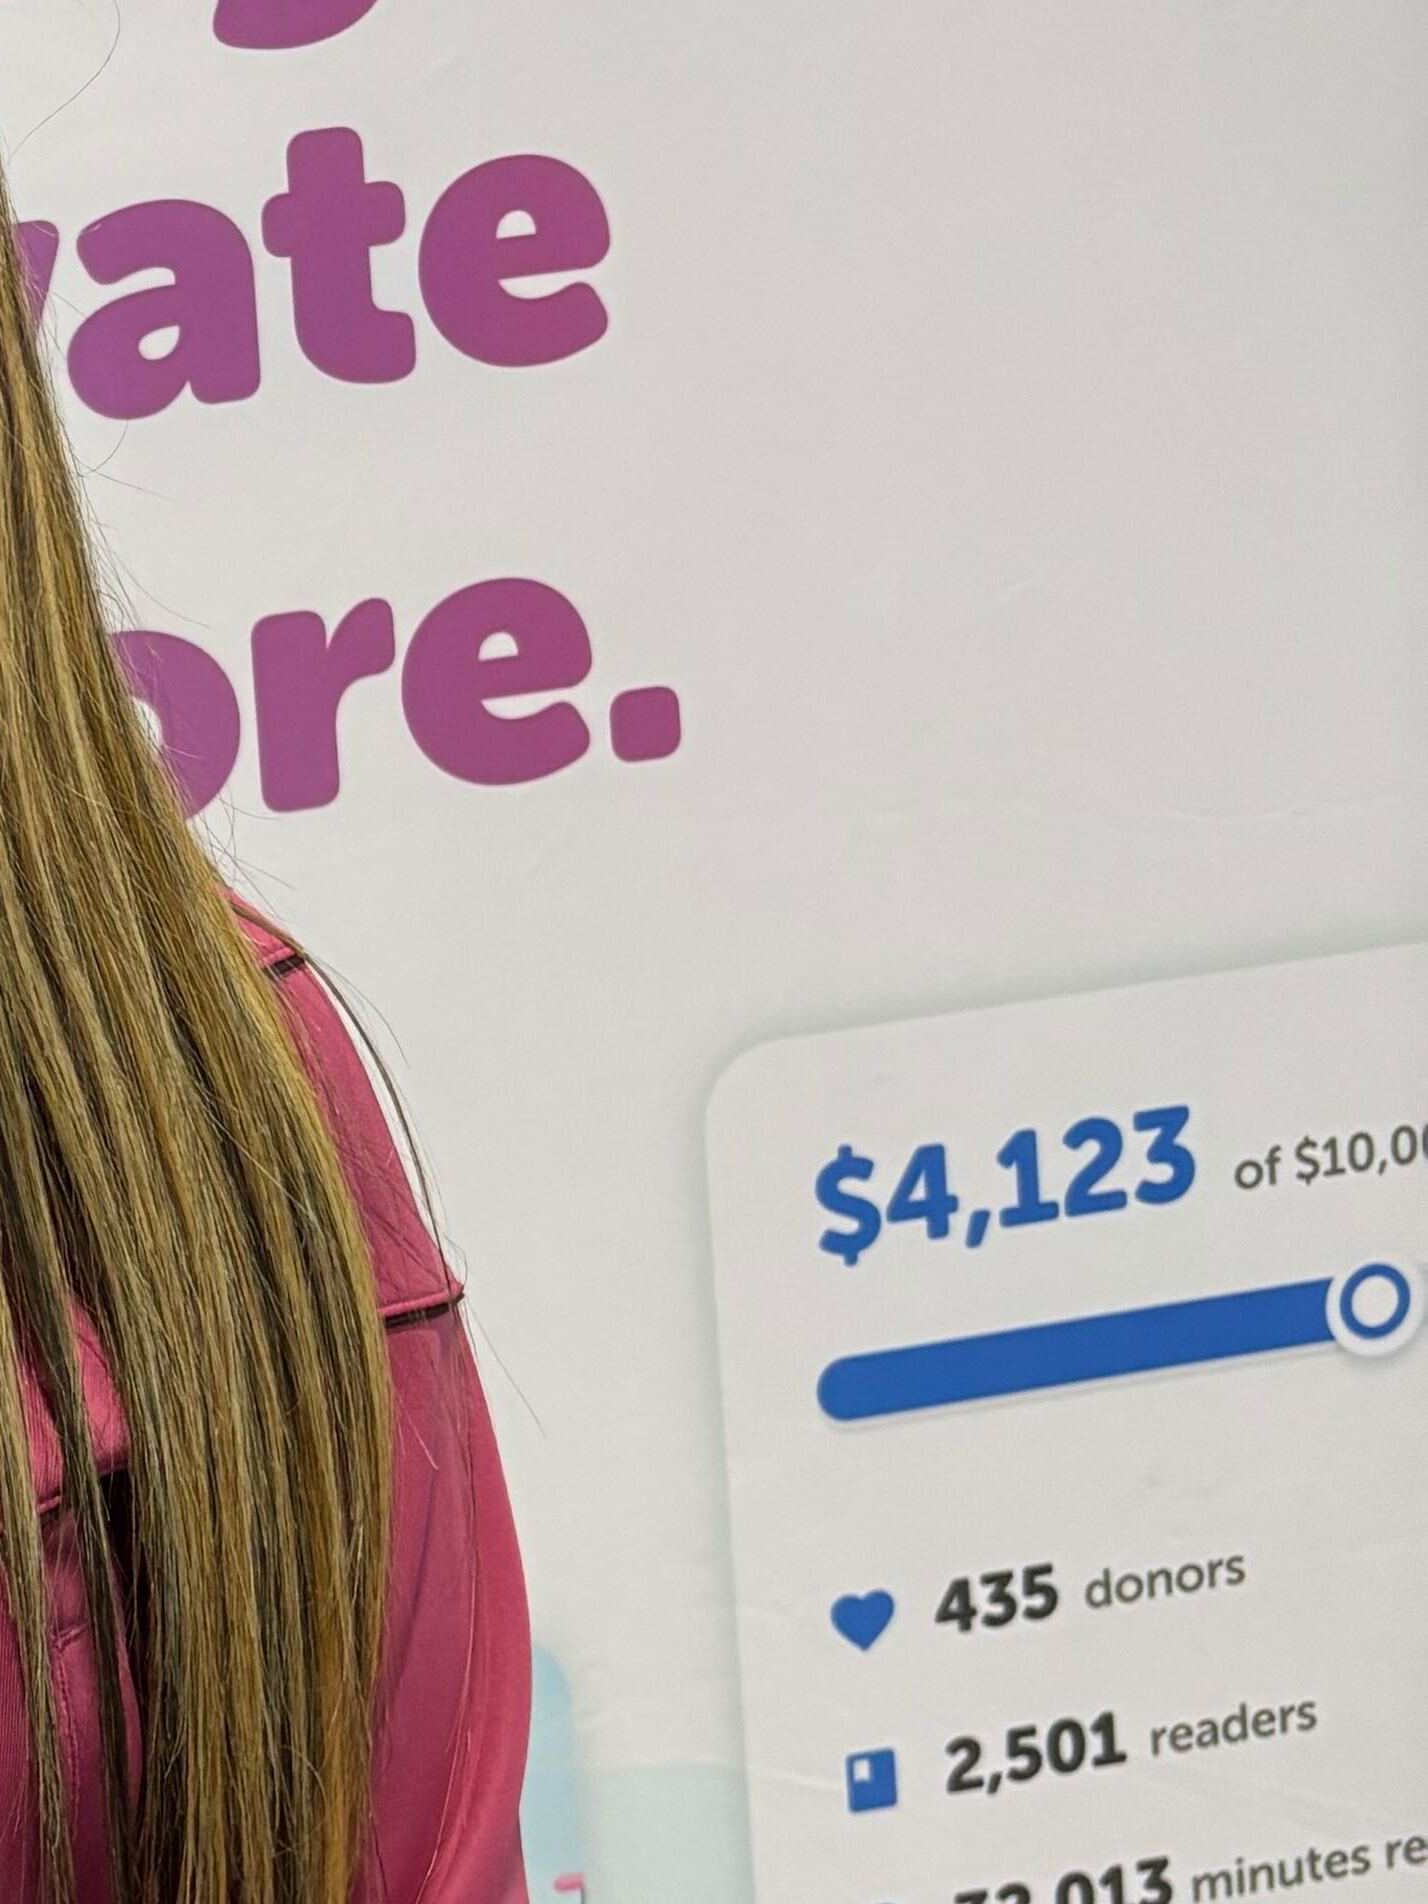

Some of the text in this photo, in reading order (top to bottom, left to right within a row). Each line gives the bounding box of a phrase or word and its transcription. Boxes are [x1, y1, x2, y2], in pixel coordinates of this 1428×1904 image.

[813, 1104, 1428, 1267] $4,123 of $10,0
[934, 1554, 1246, 1633] 435 donors
[944, 1699, 1318, 1796] 2,501 readers
[1191, 1843, 1372, 1904] minutes
[1384, 1834, 1428, 1870] re
